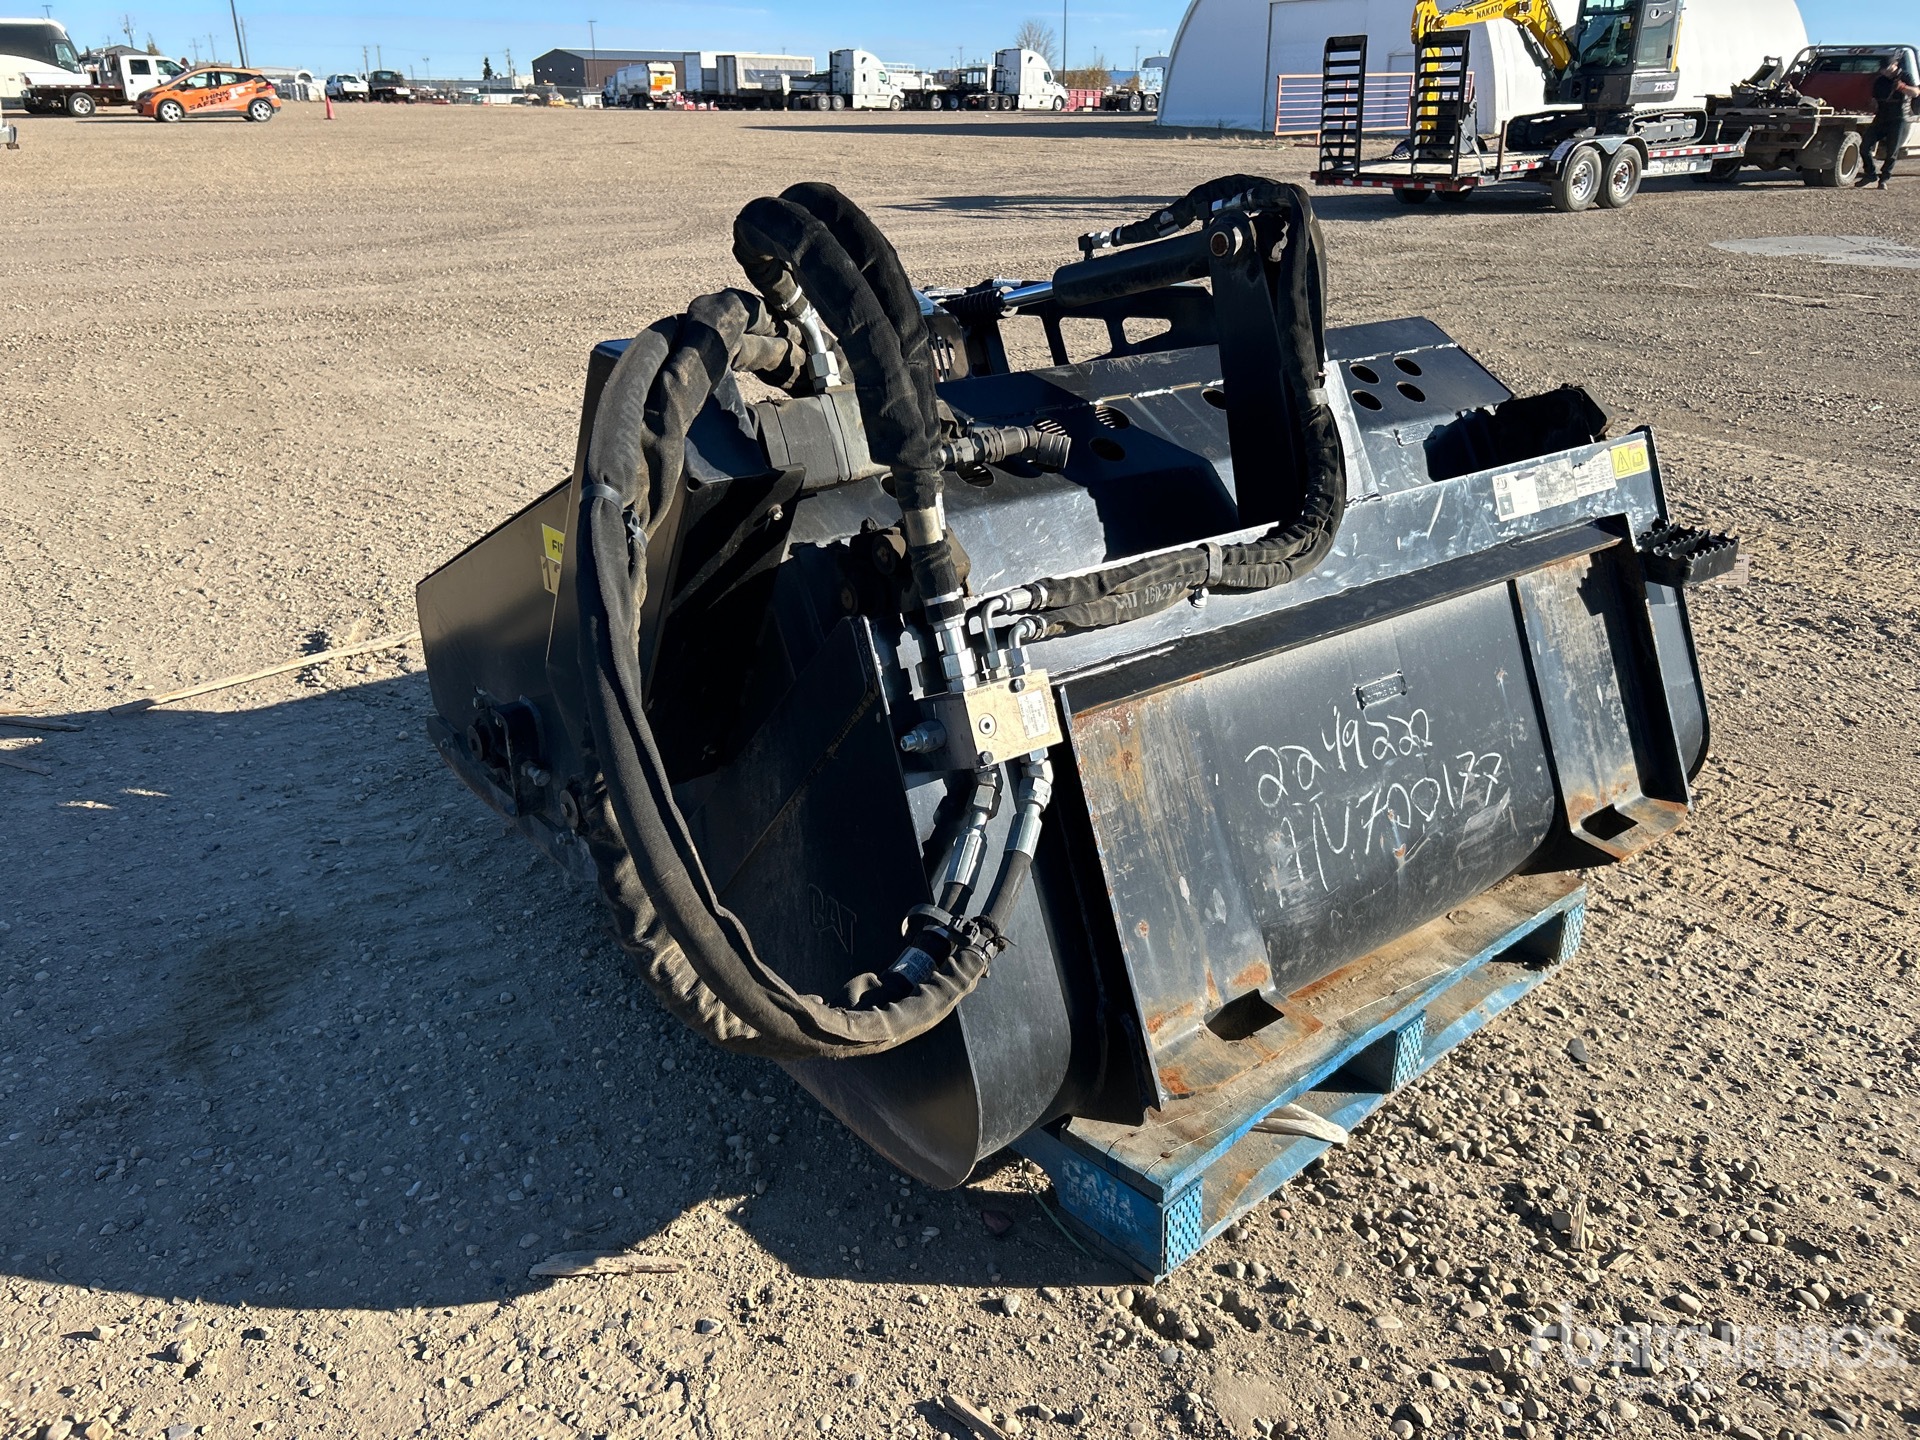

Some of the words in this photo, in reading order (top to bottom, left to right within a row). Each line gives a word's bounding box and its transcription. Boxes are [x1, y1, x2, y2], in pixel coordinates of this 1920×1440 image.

[1476, 3, 1503, 19] NAKATO
[189, 96, 230, 111] SAFETY
[199, 90, 229, 102] THINK
